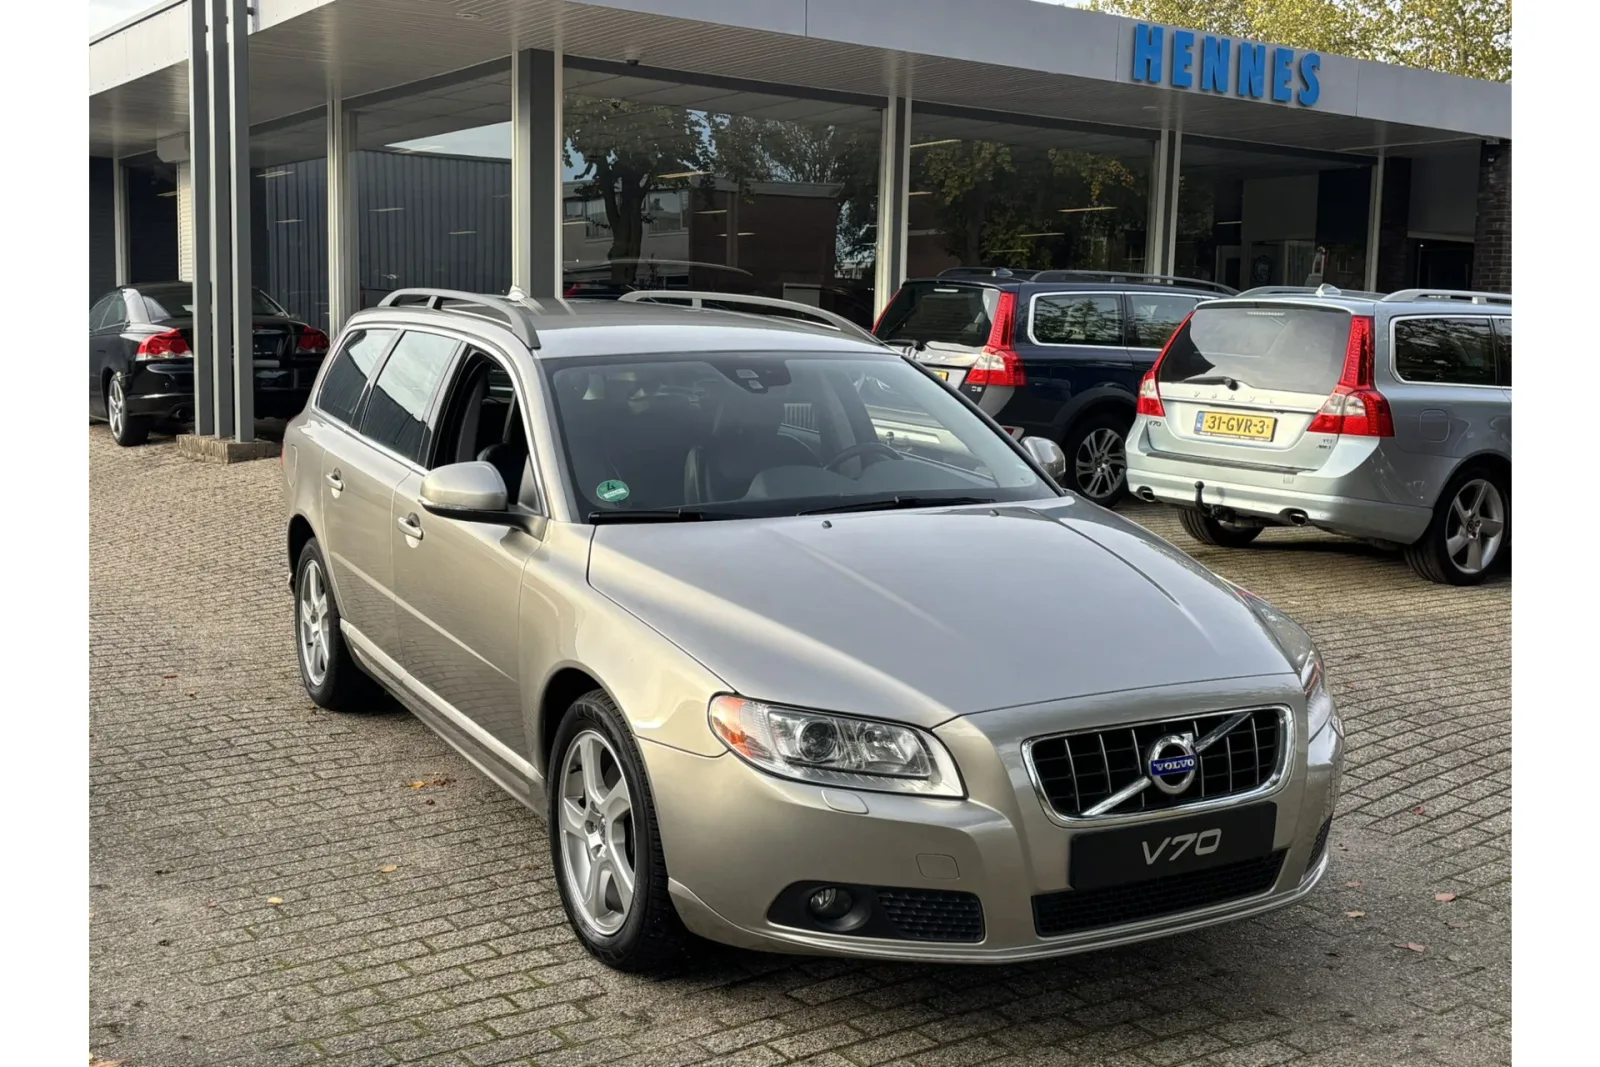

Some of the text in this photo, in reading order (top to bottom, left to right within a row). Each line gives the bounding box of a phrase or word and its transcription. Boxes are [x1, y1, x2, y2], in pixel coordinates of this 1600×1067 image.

[1134, 23, 1321, 106] HENNES
[1207, 415, 1266, 435] 31-GVR-3
[1153, 758, 1195, 772] VOLVO
[1142, 828, 1222, 866] V70
